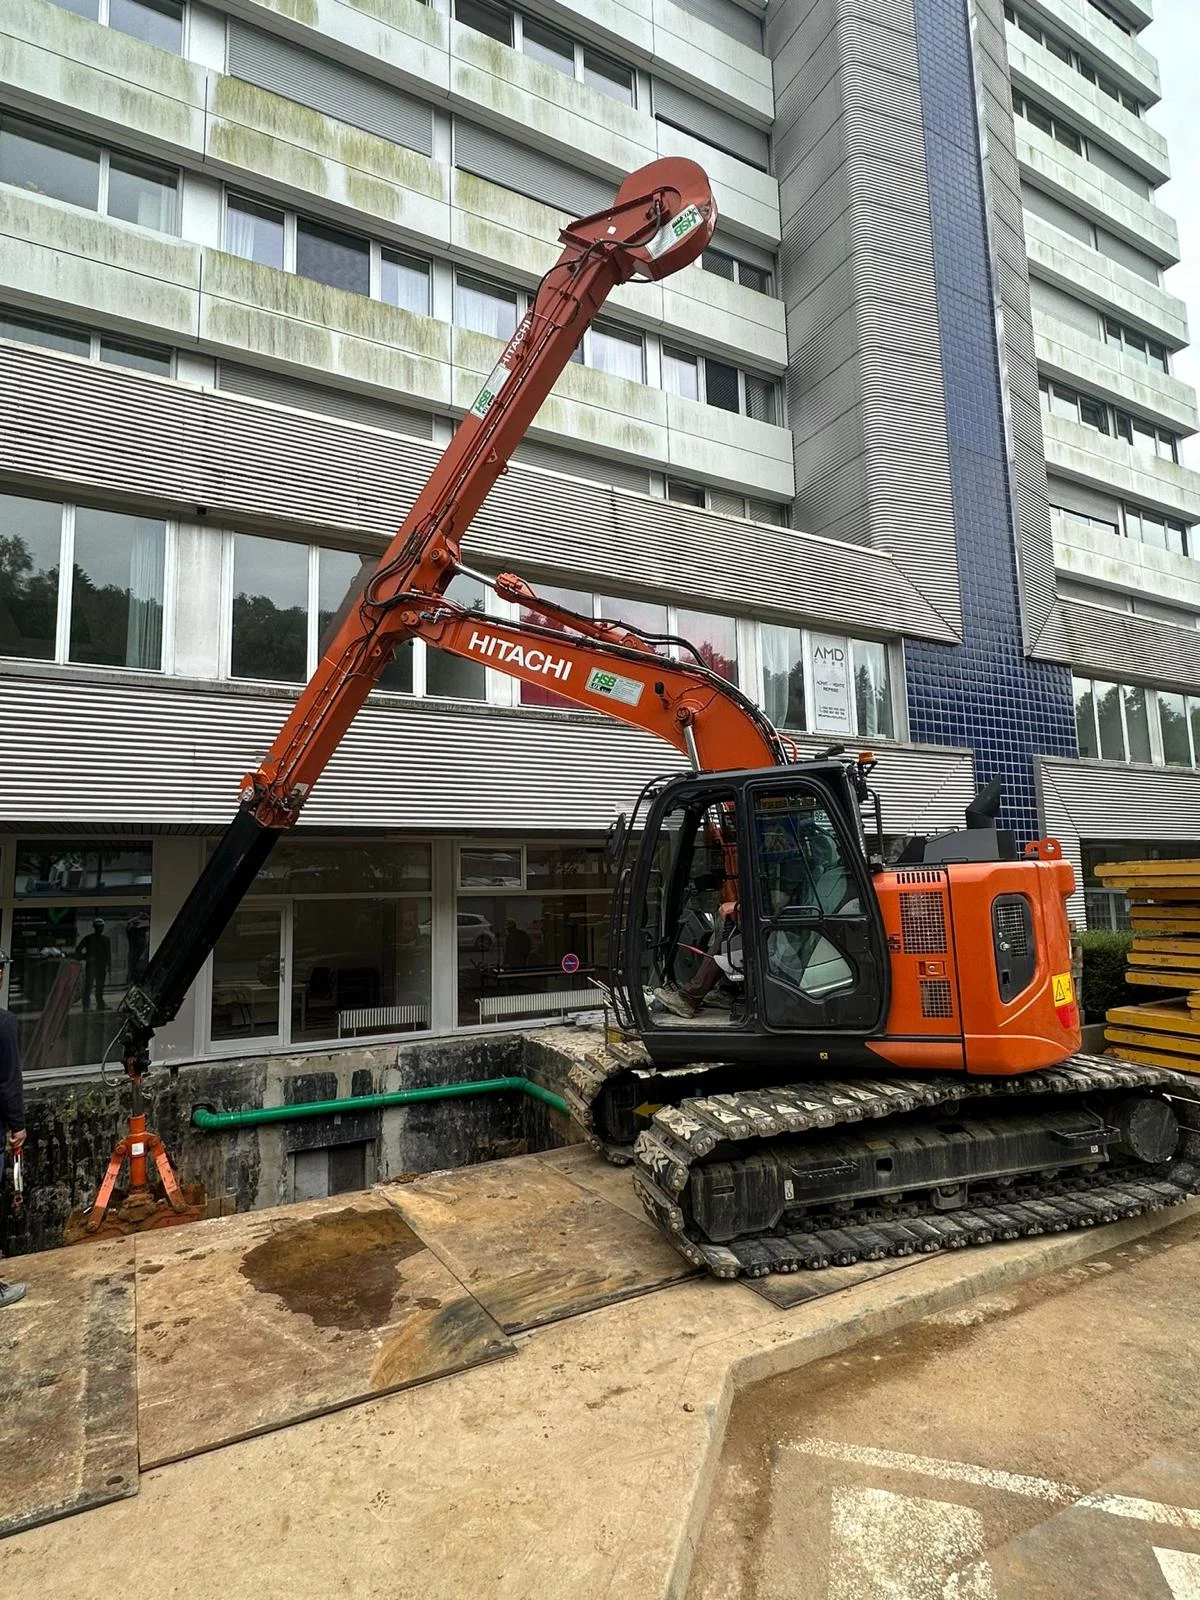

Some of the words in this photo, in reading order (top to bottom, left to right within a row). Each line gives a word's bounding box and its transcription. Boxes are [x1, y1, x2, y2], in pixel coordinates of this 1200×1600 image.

[674, 212, 698, 237] HSB
[500, 319, 531, 367] HITACHI
[475, 389, 492, 414] HSB
[468, 632, 573, 681] HITACHI
[814, 646, 844, 661] AMD
[592, 672, 617, 687] HSB
